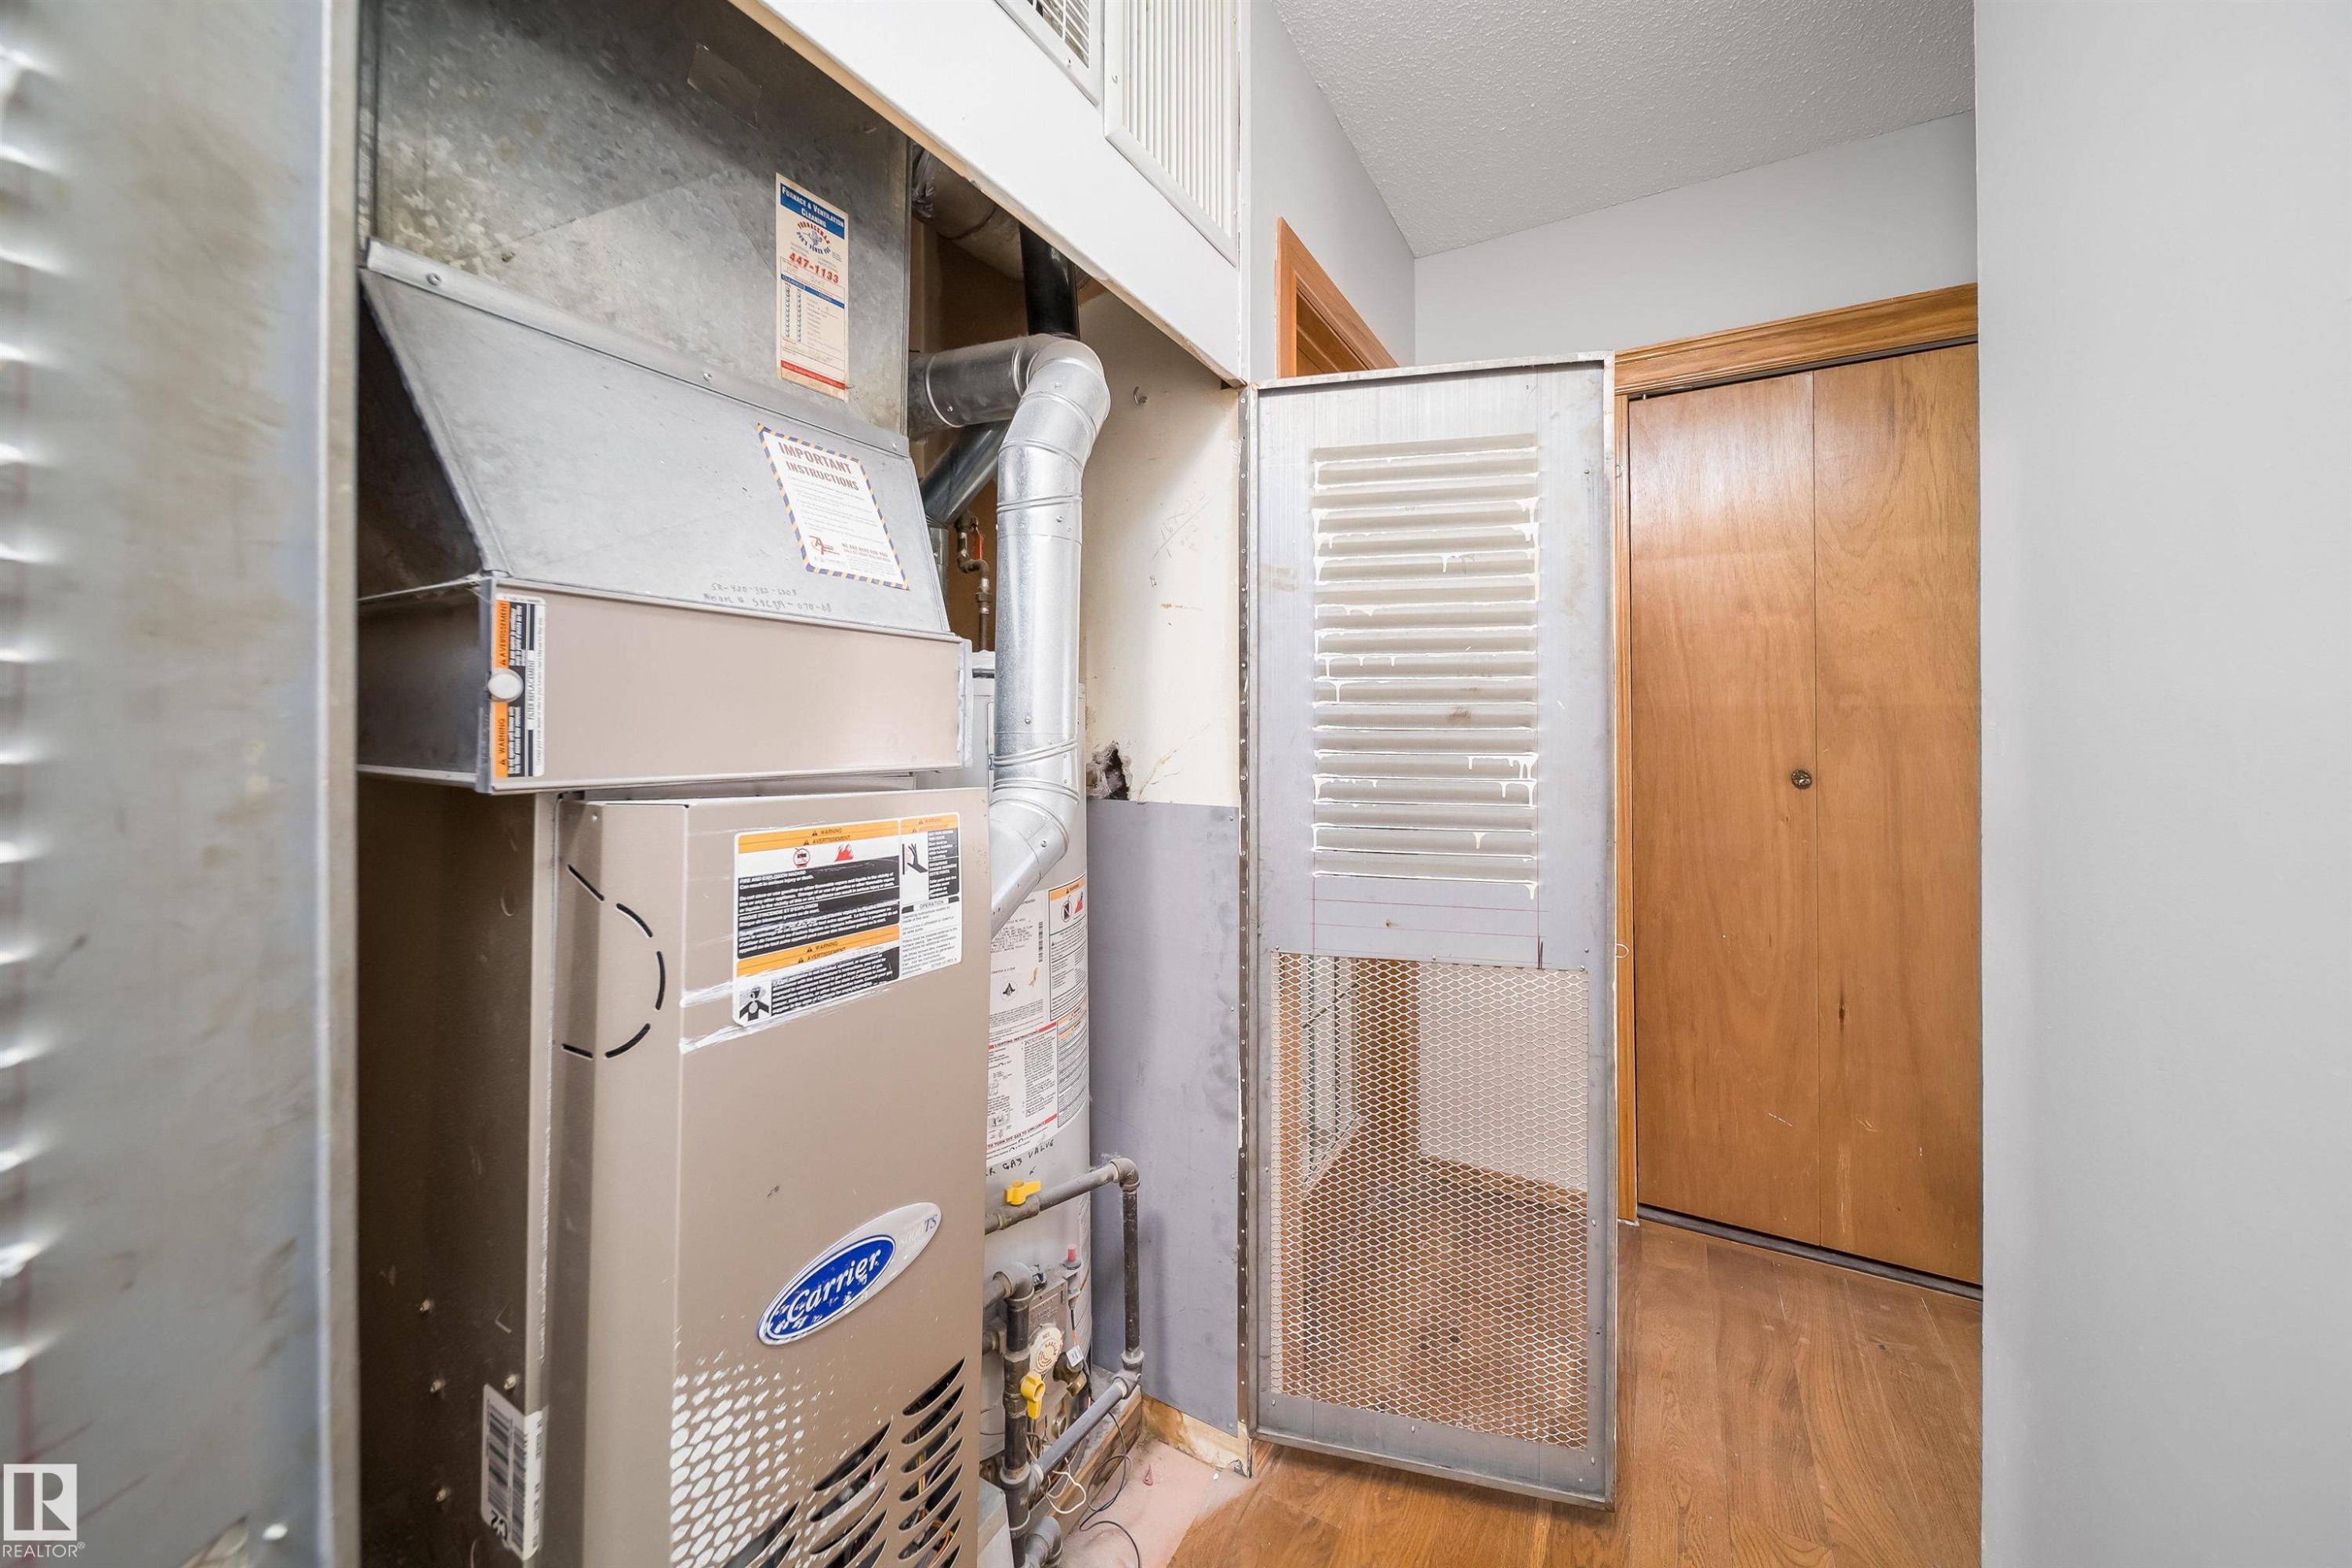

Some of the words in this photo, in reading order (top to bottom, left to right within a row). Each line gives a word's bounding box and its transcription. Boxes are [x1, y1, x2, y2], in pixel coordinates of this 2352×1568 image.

[782, 186, 807, 206] FURNACE
[813, 203, 844, 227] VENTILATION
[800, 208, 827, 227] CLEANING
[789, 252, 839, 284] 447-1133
[779, 441, 852, 474] IMPORTANT
[786, 461, 859, 491] INSTRUCTIONS
[499, 601, 507, 657] AVERTISSEMENT
[496, 717, 505, 753] WARNING
[812, 834, 850, 844] AVERTISSEMENT
[762, 872, 787, 880] EXPLOSION
[919, 899, 943, 909] OPERATION
[815, 940, 837, 950] WARNING
[994, 1039, 1013, 1047] LIGHTING
[1014, 1030, 1038, 1041] INSTRUCTIONS
[1002, 1158, 1023, 1170] GAS
[1028, 1138, 1054, 1159] VALVE
[786, 1249, 881, 1323] Carrier
